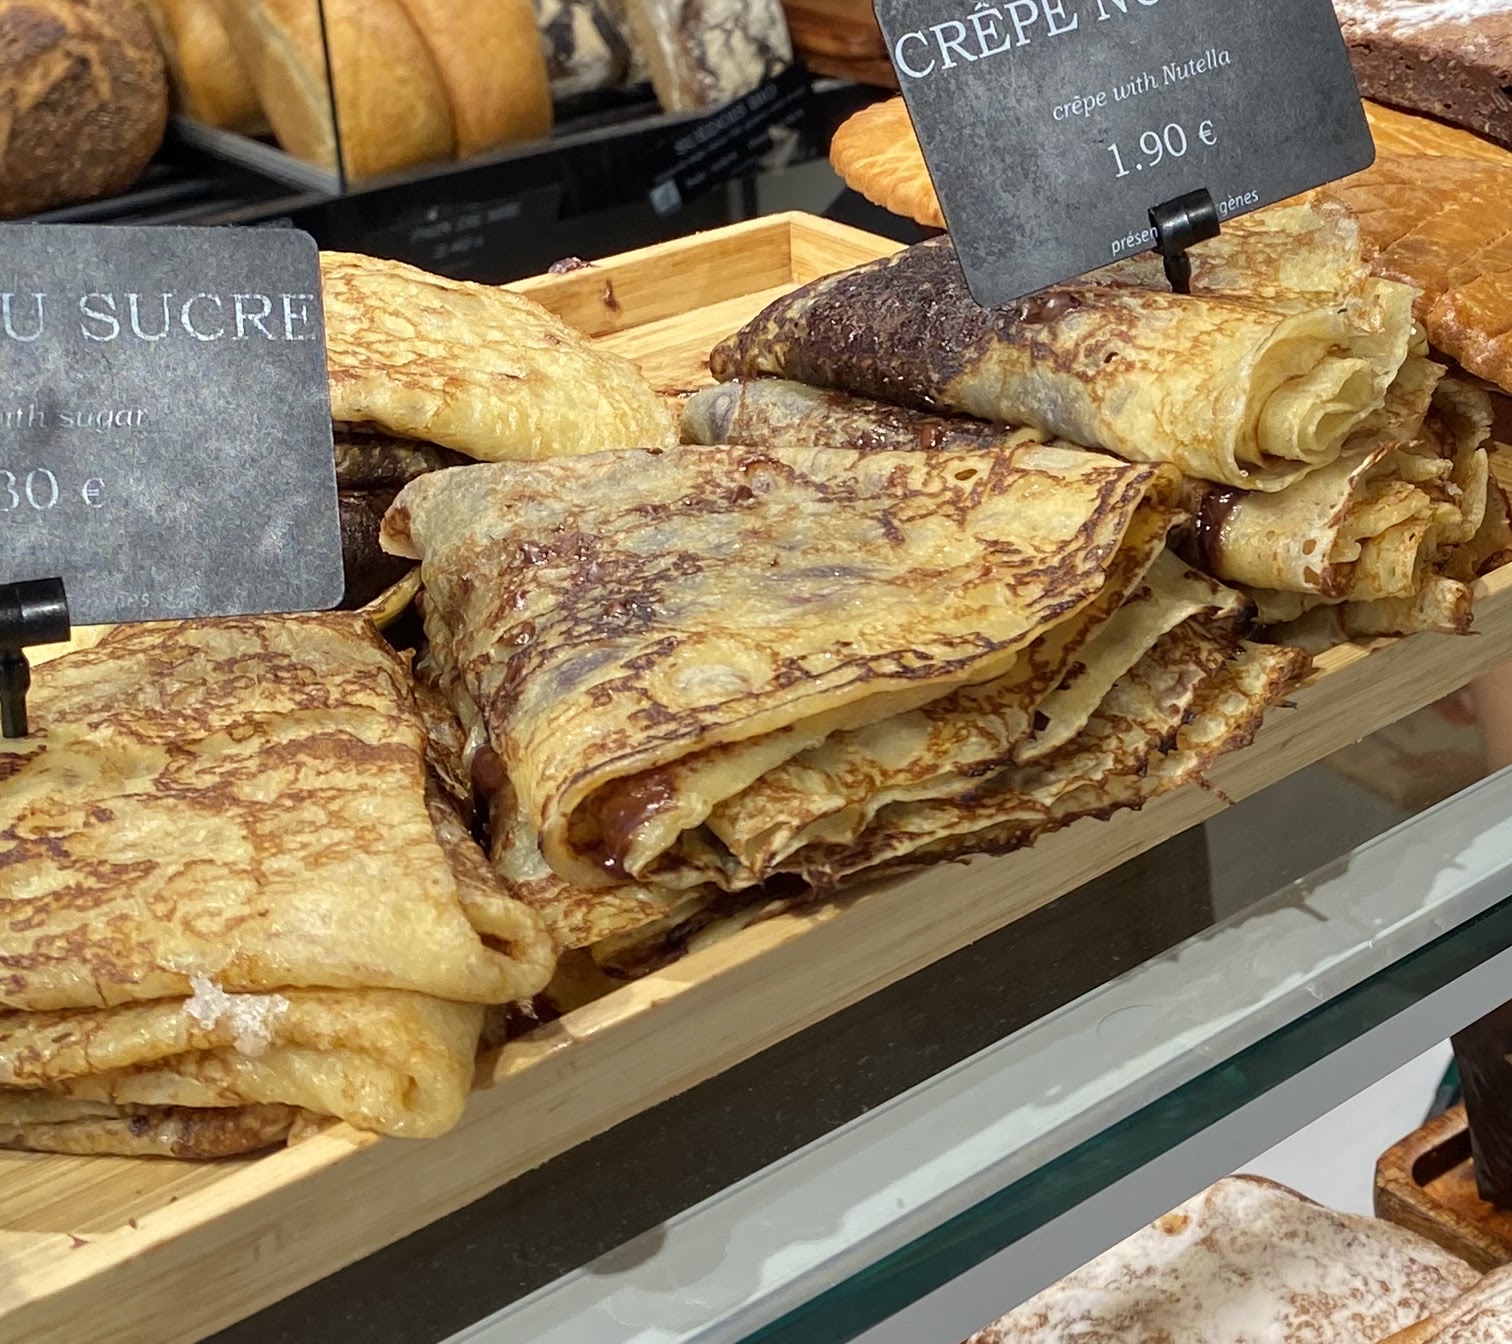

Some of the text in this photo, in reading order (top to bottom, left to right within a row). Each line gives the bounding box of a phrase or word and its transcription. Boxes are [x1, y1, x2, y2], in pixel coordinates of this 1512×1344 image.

[1052, 48, 1232, 121] crêpe with Nutella
[1108, 119, 1217, 178] 1.90 €
[1111, 189, 1259, 255] présen gènes
[0, 292, 317, 343] U SUCRE
[0, 403, 149, 433] ith sugar
[81, 478, 105, 509] €
